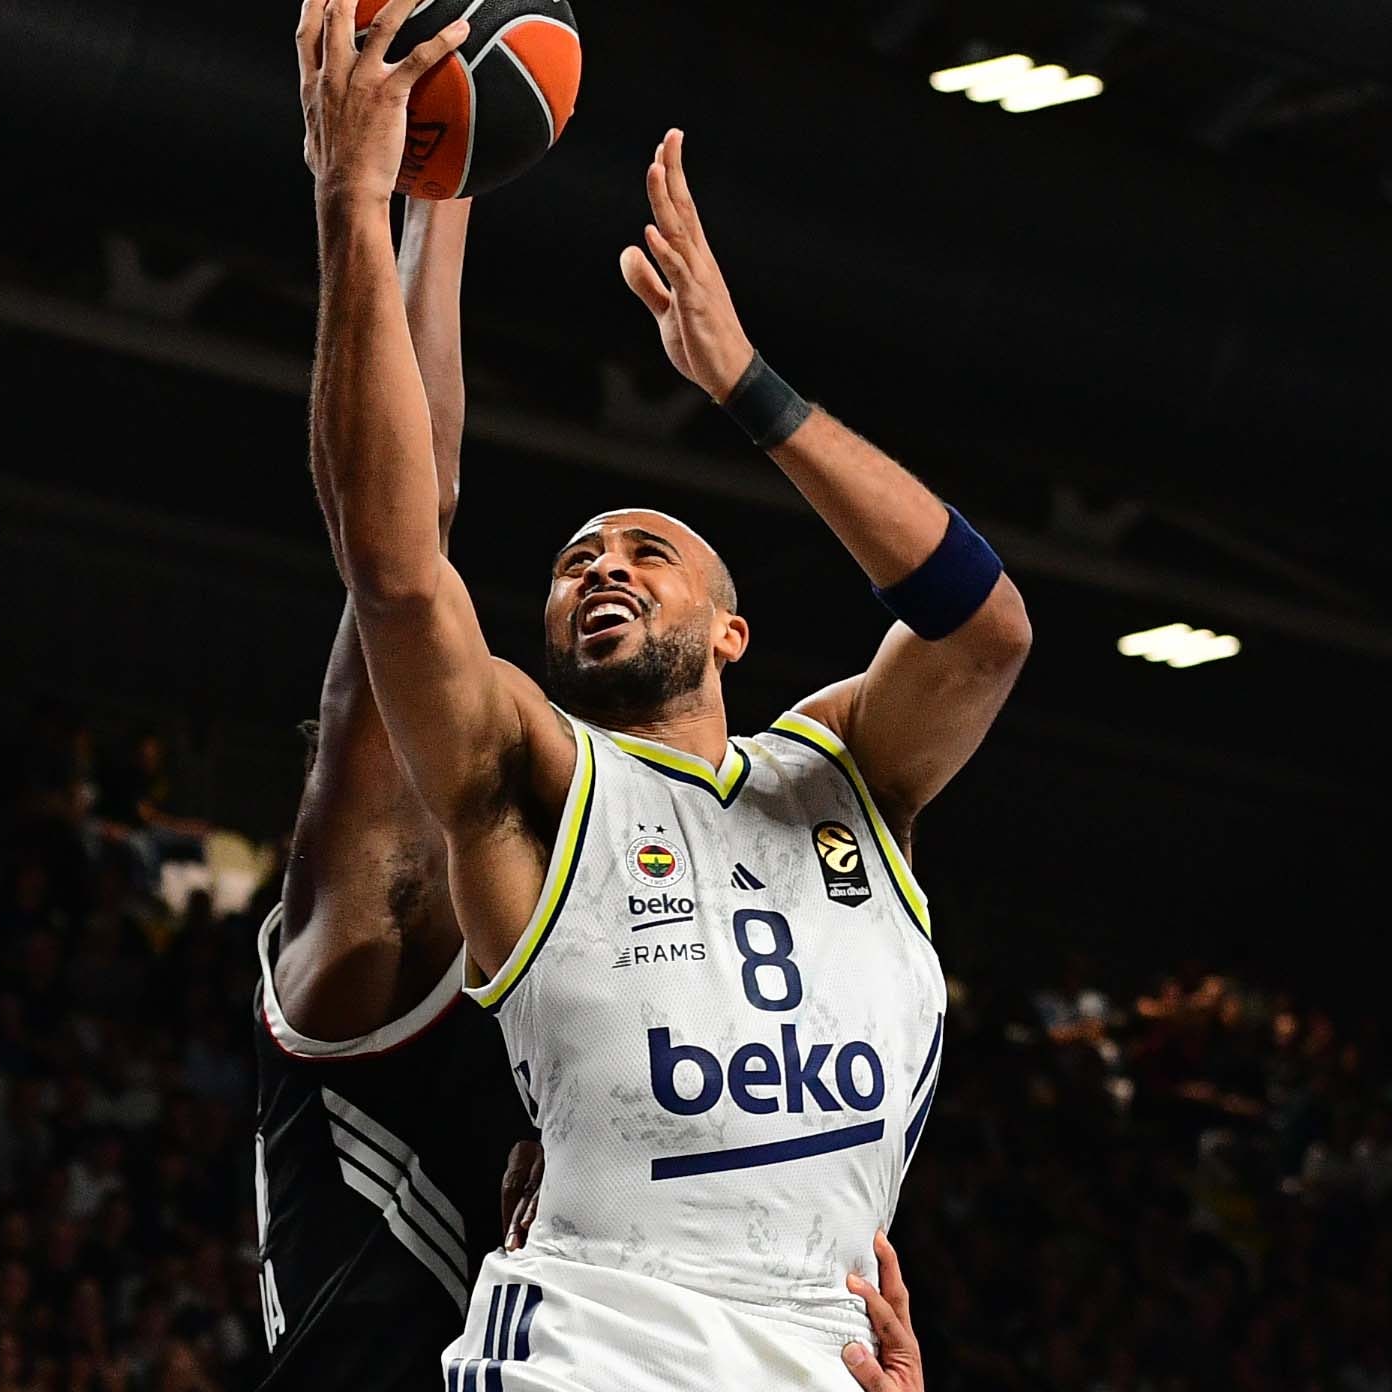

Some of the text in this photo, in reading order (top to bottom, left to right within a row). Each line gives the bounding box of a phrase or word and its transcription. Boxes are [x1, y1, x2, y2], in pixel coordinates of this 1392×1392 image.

[628, 893, 694, 915] beko
[634, 942, 706, 965] RAMS
[732, 908, 803, 1012] 8
[647, 1023, 885, 1116] beko
